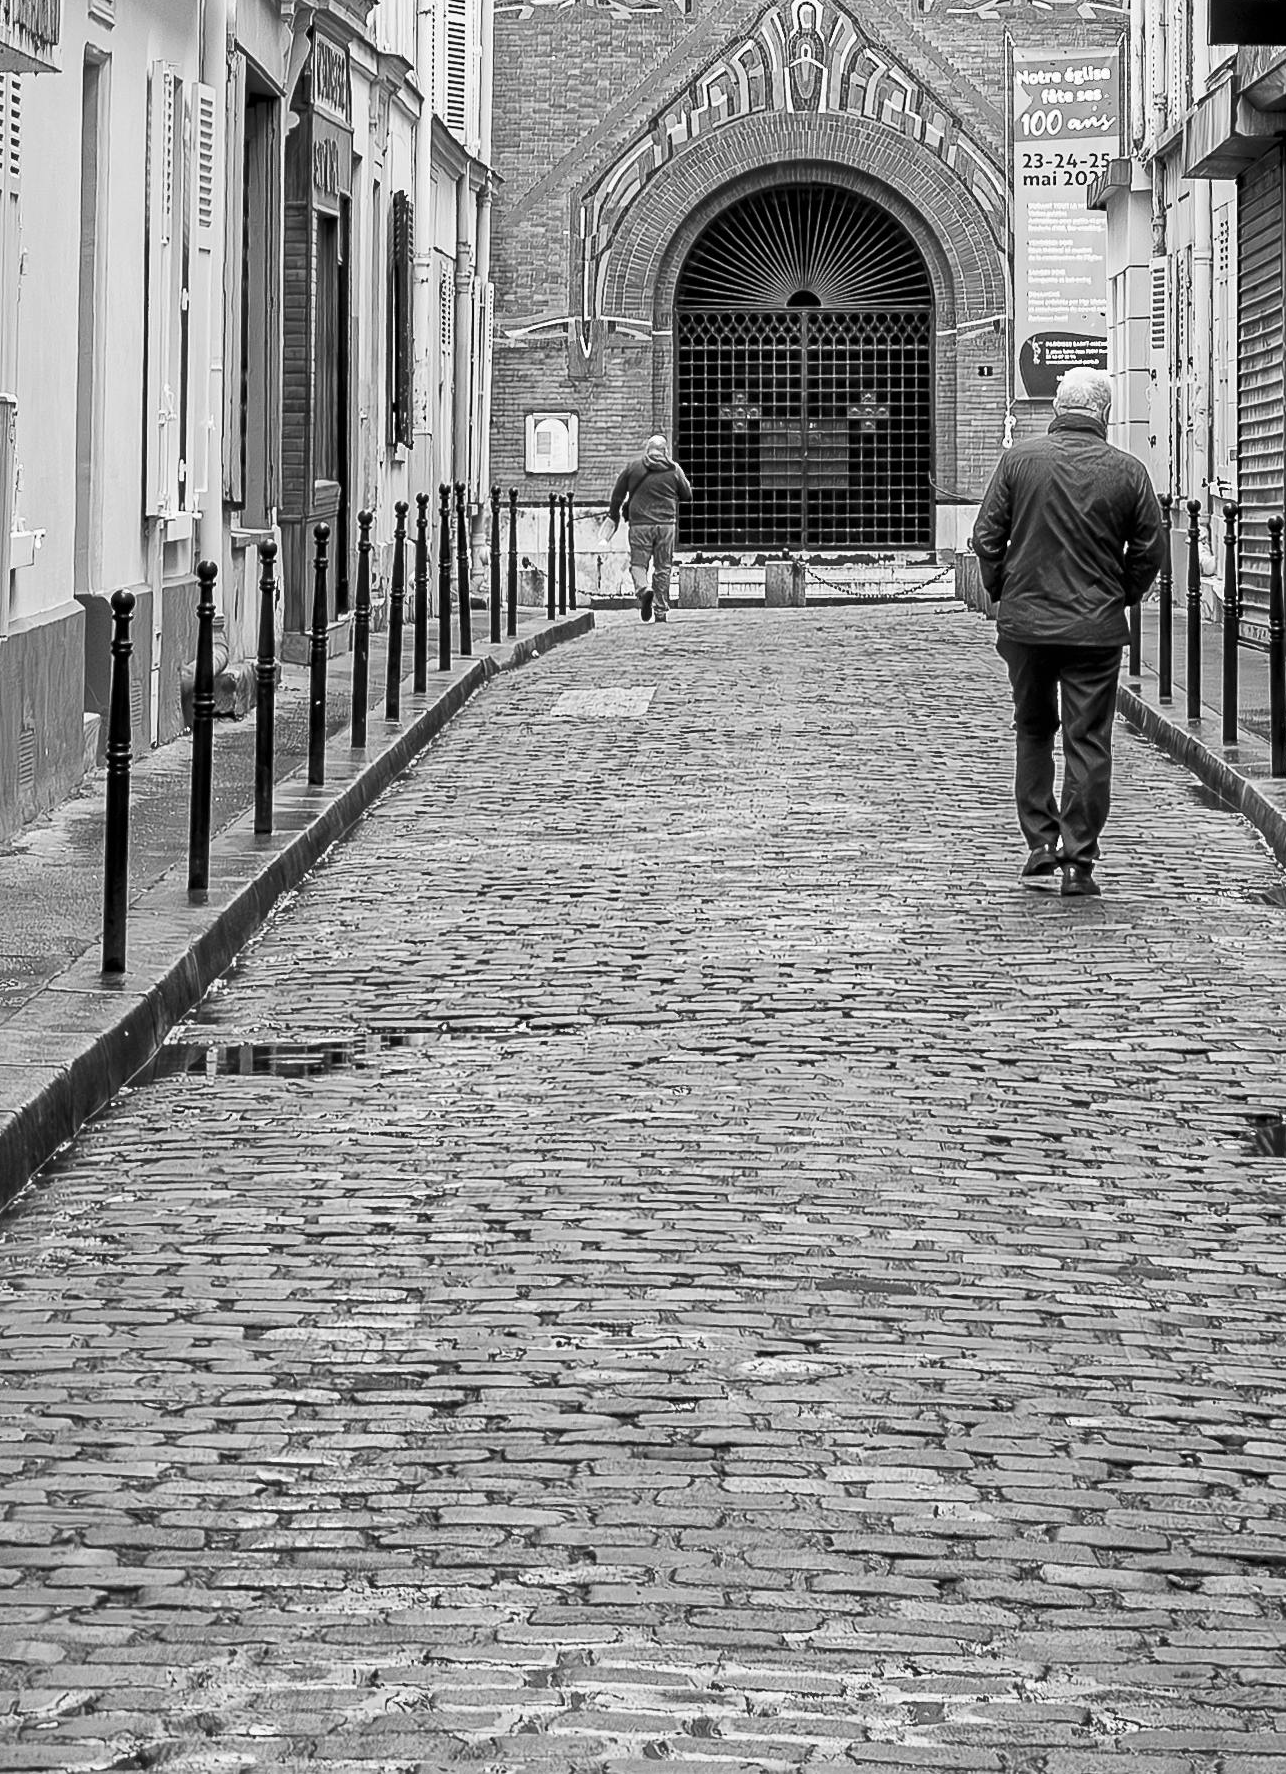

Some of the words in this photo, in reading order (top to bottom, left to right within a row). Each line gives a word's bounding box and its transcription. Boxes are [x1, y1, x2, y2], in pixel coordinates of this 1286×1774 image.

[1016, 70, 1062, 85] Notre
[1064, 65, 1111, 85] église
[1041, 88, 1074, 105] fête
[1076, 88, 1102, 102] ses
[1021, 109, 1063, 136] 100
[1067, 113, 1116, 131] ans
[1022, 153, 1110, 168] 23-24-25
[1023, 171, 1057, 186] mai
